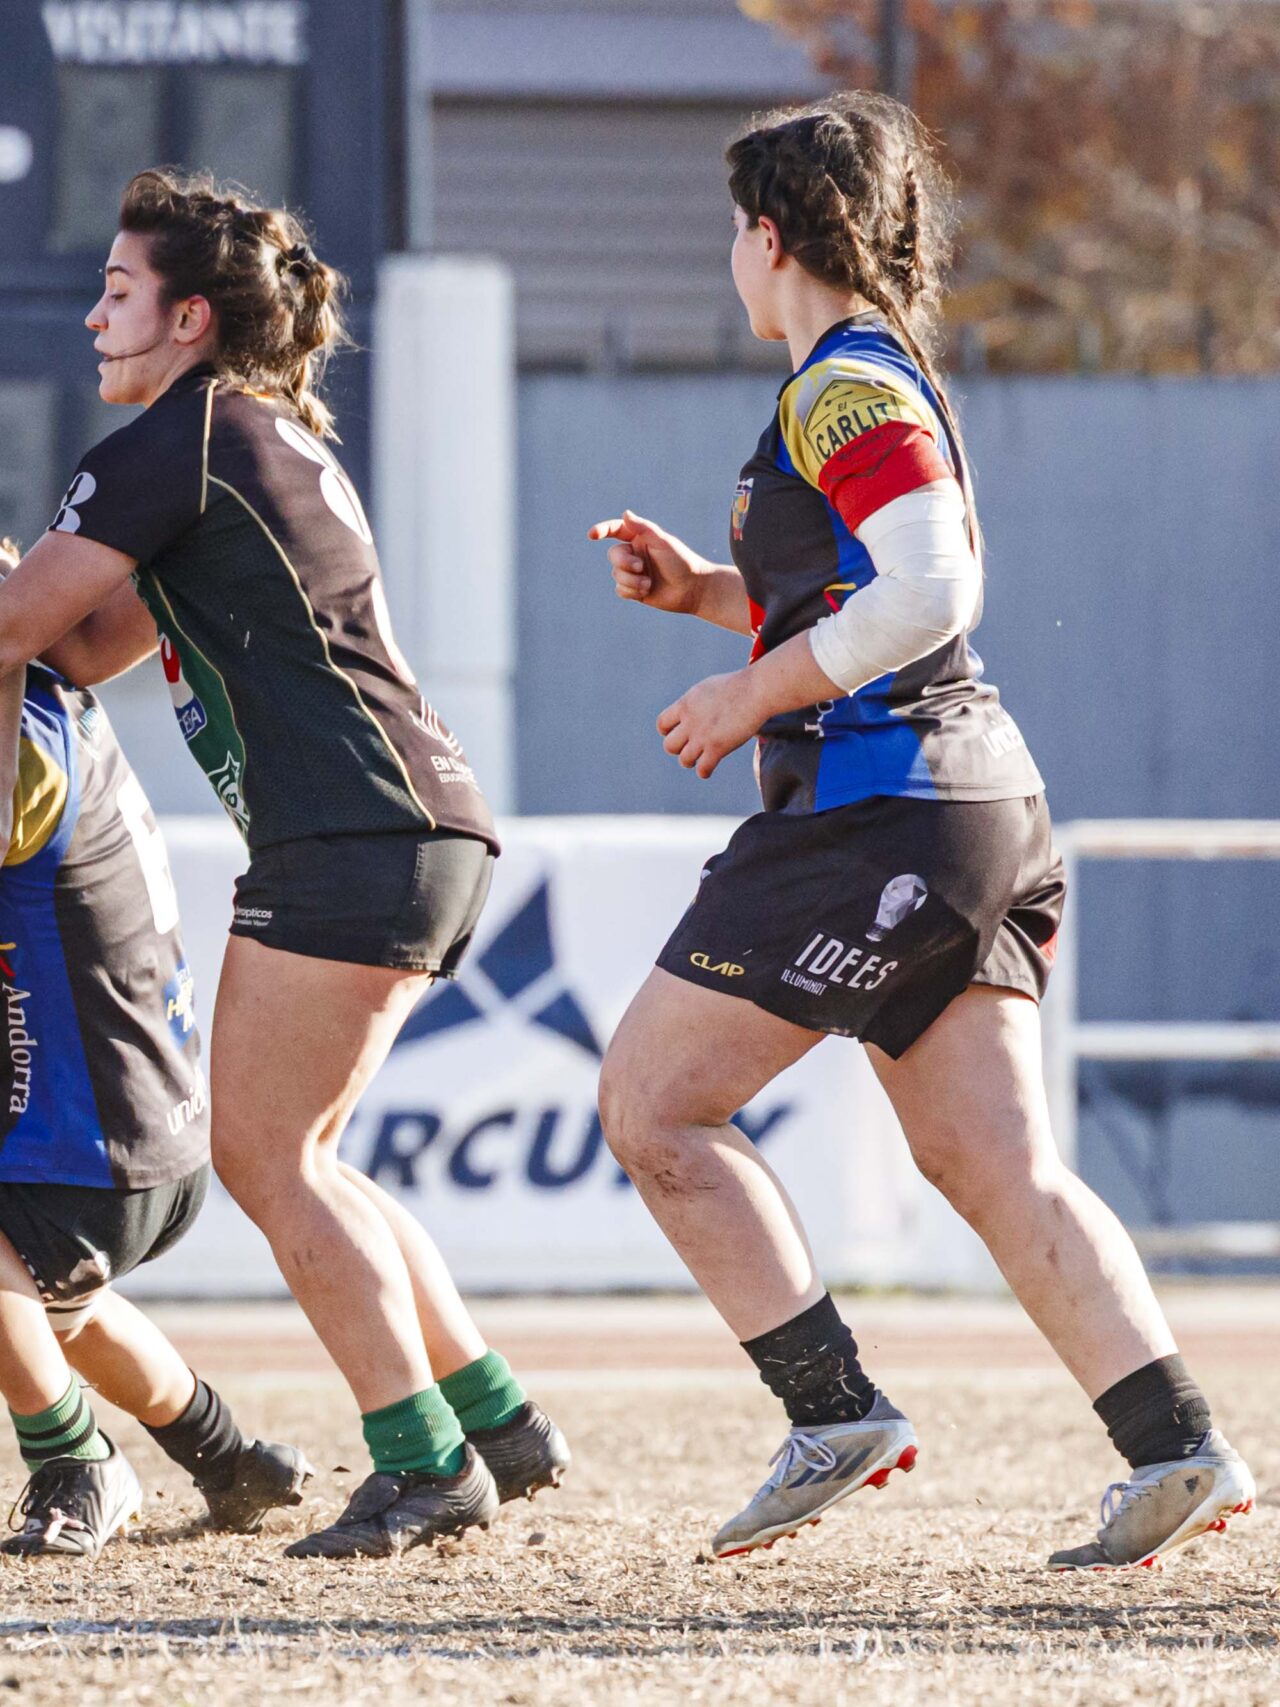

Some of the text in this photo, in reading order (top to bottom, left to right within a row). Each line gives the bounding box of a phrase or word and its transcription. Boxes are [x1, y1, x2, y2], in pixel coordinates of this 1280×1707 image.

[42, 2, 308, 65] VISITANTE
[816, 402, 892, 461] CARLIT
[690, 952, 745, 977] CLAP
[794, 933, 899, 991] IDEES
[2, 982, 38, 1114] Andorra
